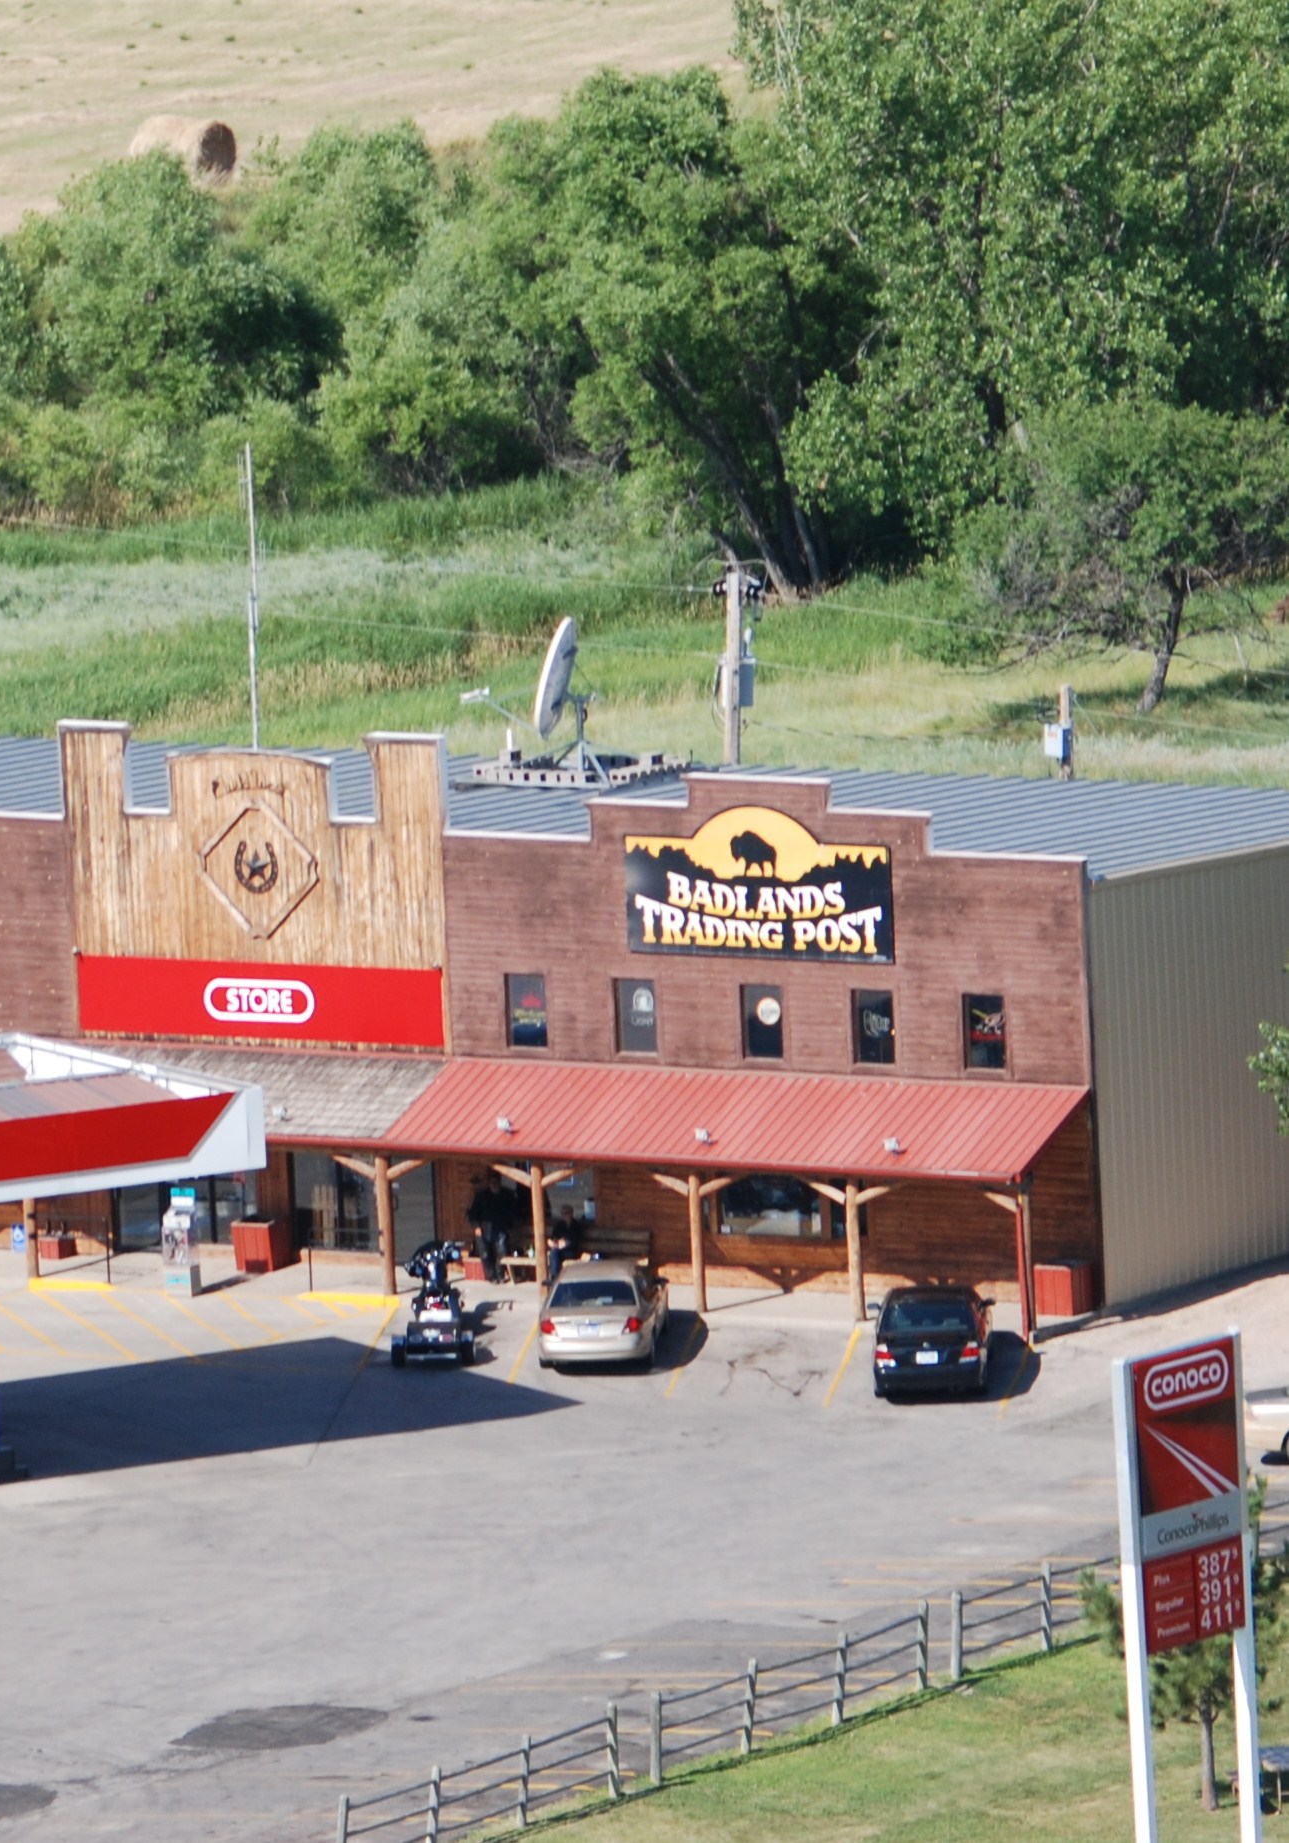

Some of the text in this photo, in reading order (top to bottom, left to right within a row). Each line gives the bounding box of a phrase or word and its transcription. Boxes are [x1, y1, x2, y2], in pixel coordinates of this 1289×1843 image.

[666, 871, 846, 920] BADLANDS
[634, 893, 882, 954] TRADING POST
[226, 987, 293, 1014] STORE
[1157, 1513, 1229, 1545] ConocoPhillips
[1155, 1597, 1184, 1612] Regular
[1157, 1622, 1190, 1638] Premium
